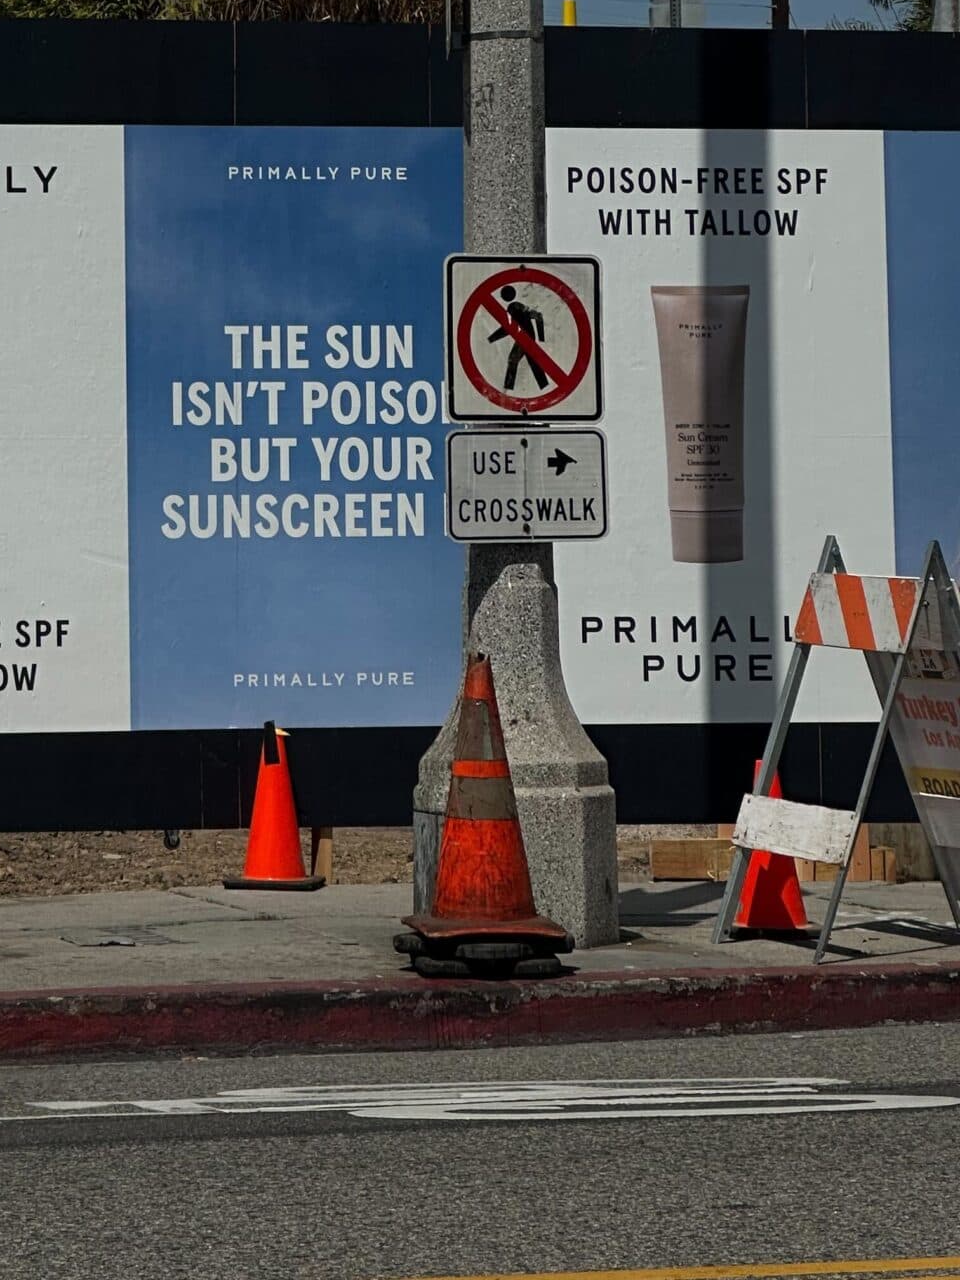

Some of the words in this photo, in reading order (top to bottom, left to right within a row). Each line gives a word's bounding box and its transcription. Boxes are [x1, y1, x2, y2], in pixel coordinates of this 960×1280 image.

[229, 167, 338, 180] PRIMALLY
[351, 167, 407, 180] PURE
[568, 167, 764, 195] POISON-FREE
[777, 168, 827, 194] SPF
[599, 209, 671, 235] WITH
[685, 209, 798, 235] TALLOW
[225, 325, 309, 368] THE
[325, 325, 412, 368] SUN
[173, 381, 285, 425] ISN'T
[678, 432, 695, 442] Sun
[686, 444, 705, 455] SPF
[212, 438, 297, 481] BUT
[312, 437, 434, 481] YOUR
[473, 451, 516, 475] USE
[161, 493, 424, 538] SUNSCREEN
[459, 498, 596, 523] CROSSWALK
[15, 619, 70, 647] SPF
[582, 616, 793, 644] PRIMALL
[234, 673, 344, 687] PRIMALLY
[357, 672, 414, 686] PURE
[643, 655, 773, 682] PURE
[923, 728, 945, 746] Los
